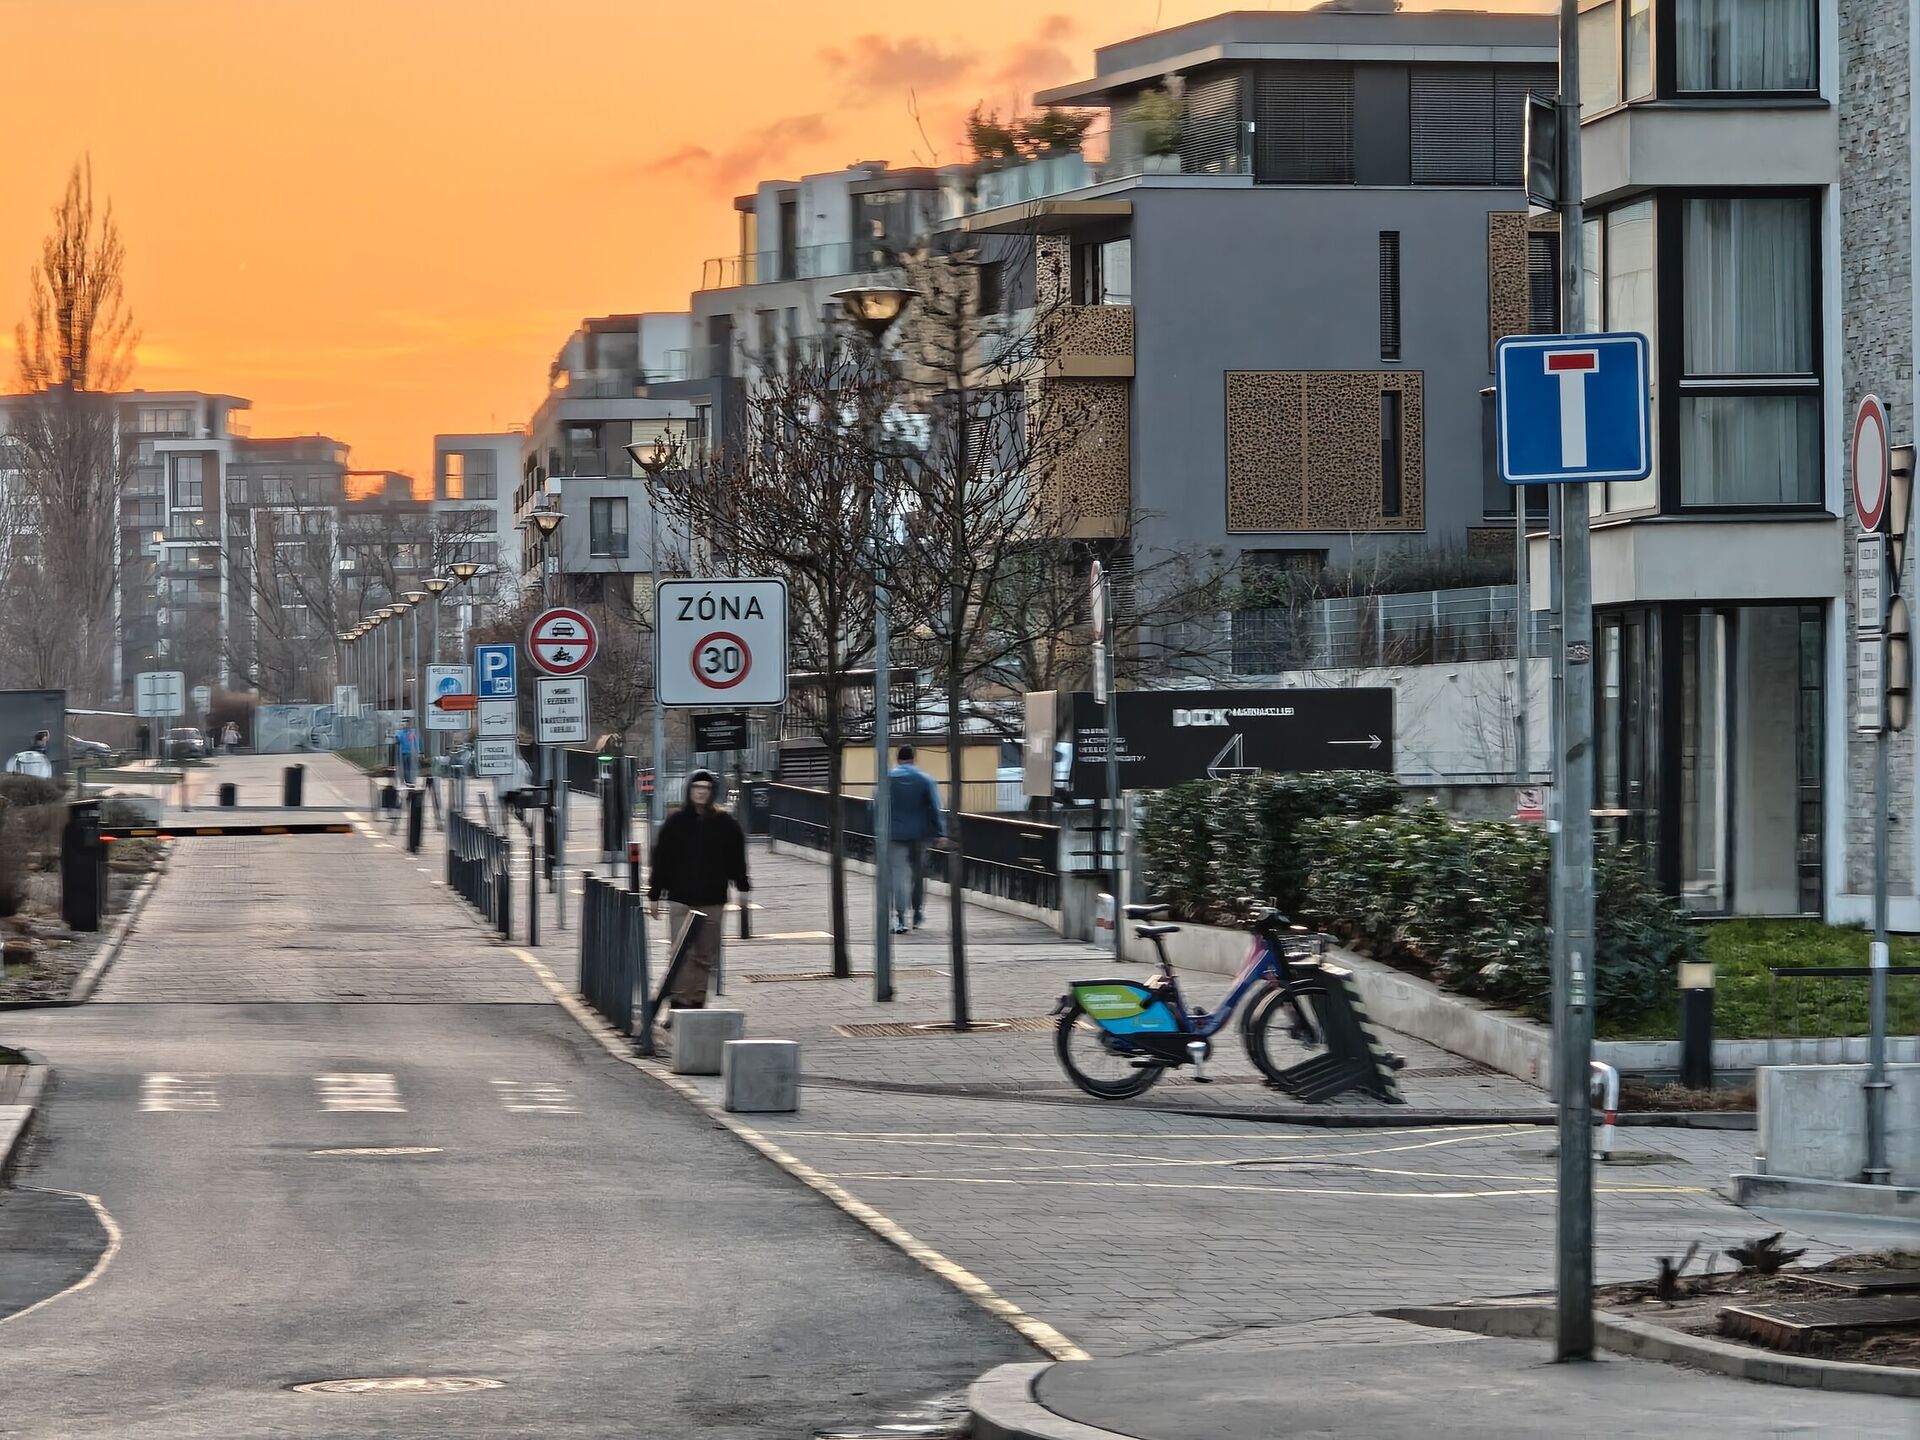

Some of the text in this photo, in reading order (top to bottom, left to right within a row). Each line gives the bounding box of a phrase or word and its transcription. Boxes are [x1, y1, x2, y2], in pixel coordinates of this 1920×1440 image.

[677, 591, 764, 621] ZÓNA
[484, 652, 508, 681] P
[704, 646, 739, 674] 30
